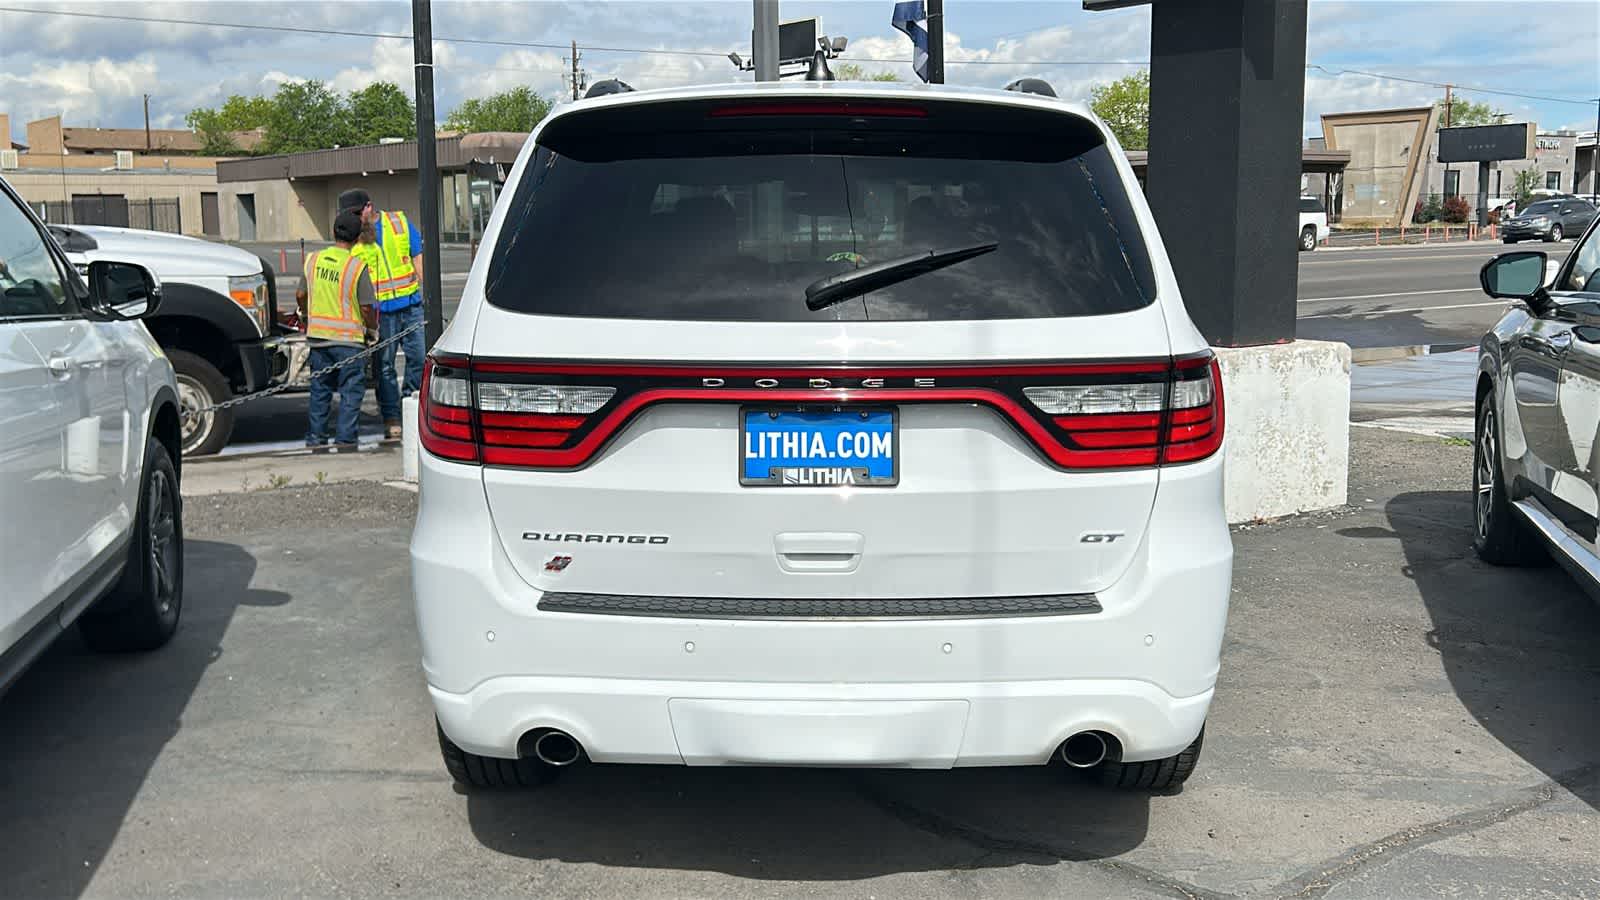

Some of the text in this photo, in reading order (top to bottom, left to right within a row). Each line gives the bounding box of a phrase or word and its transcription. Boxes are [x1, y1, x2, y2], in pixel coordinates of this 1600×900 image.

[702, 378, 936, 388] DODGE
[745, 431, 892, 458] LITHIA.COM
[799, 467, 856, 484] LITHIA
[522, 532, 669, 544] DURANGO
[1080, 533, 1125, 543] GT
